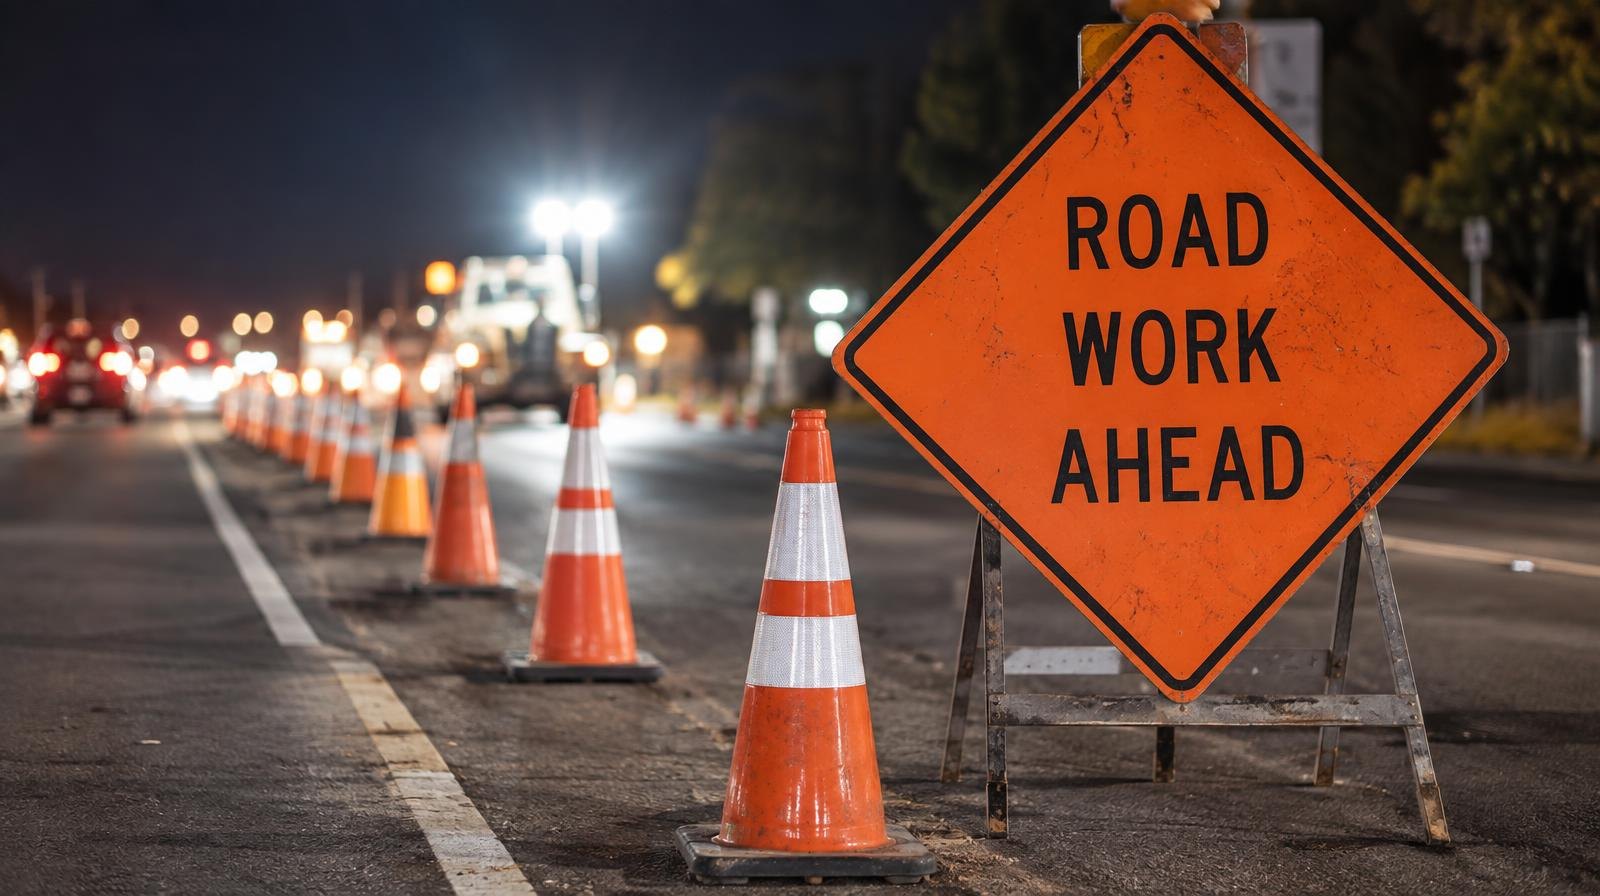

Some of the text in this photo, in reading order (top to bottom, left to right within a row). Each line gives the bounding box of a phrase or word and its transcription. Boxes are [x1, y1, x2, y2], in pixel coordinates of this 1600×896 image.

[1066, 191, 1269, 271] ROAD
[1062, 307, 1281, 387] WORK
[1051, 424, 1305, 504] AHEAD
